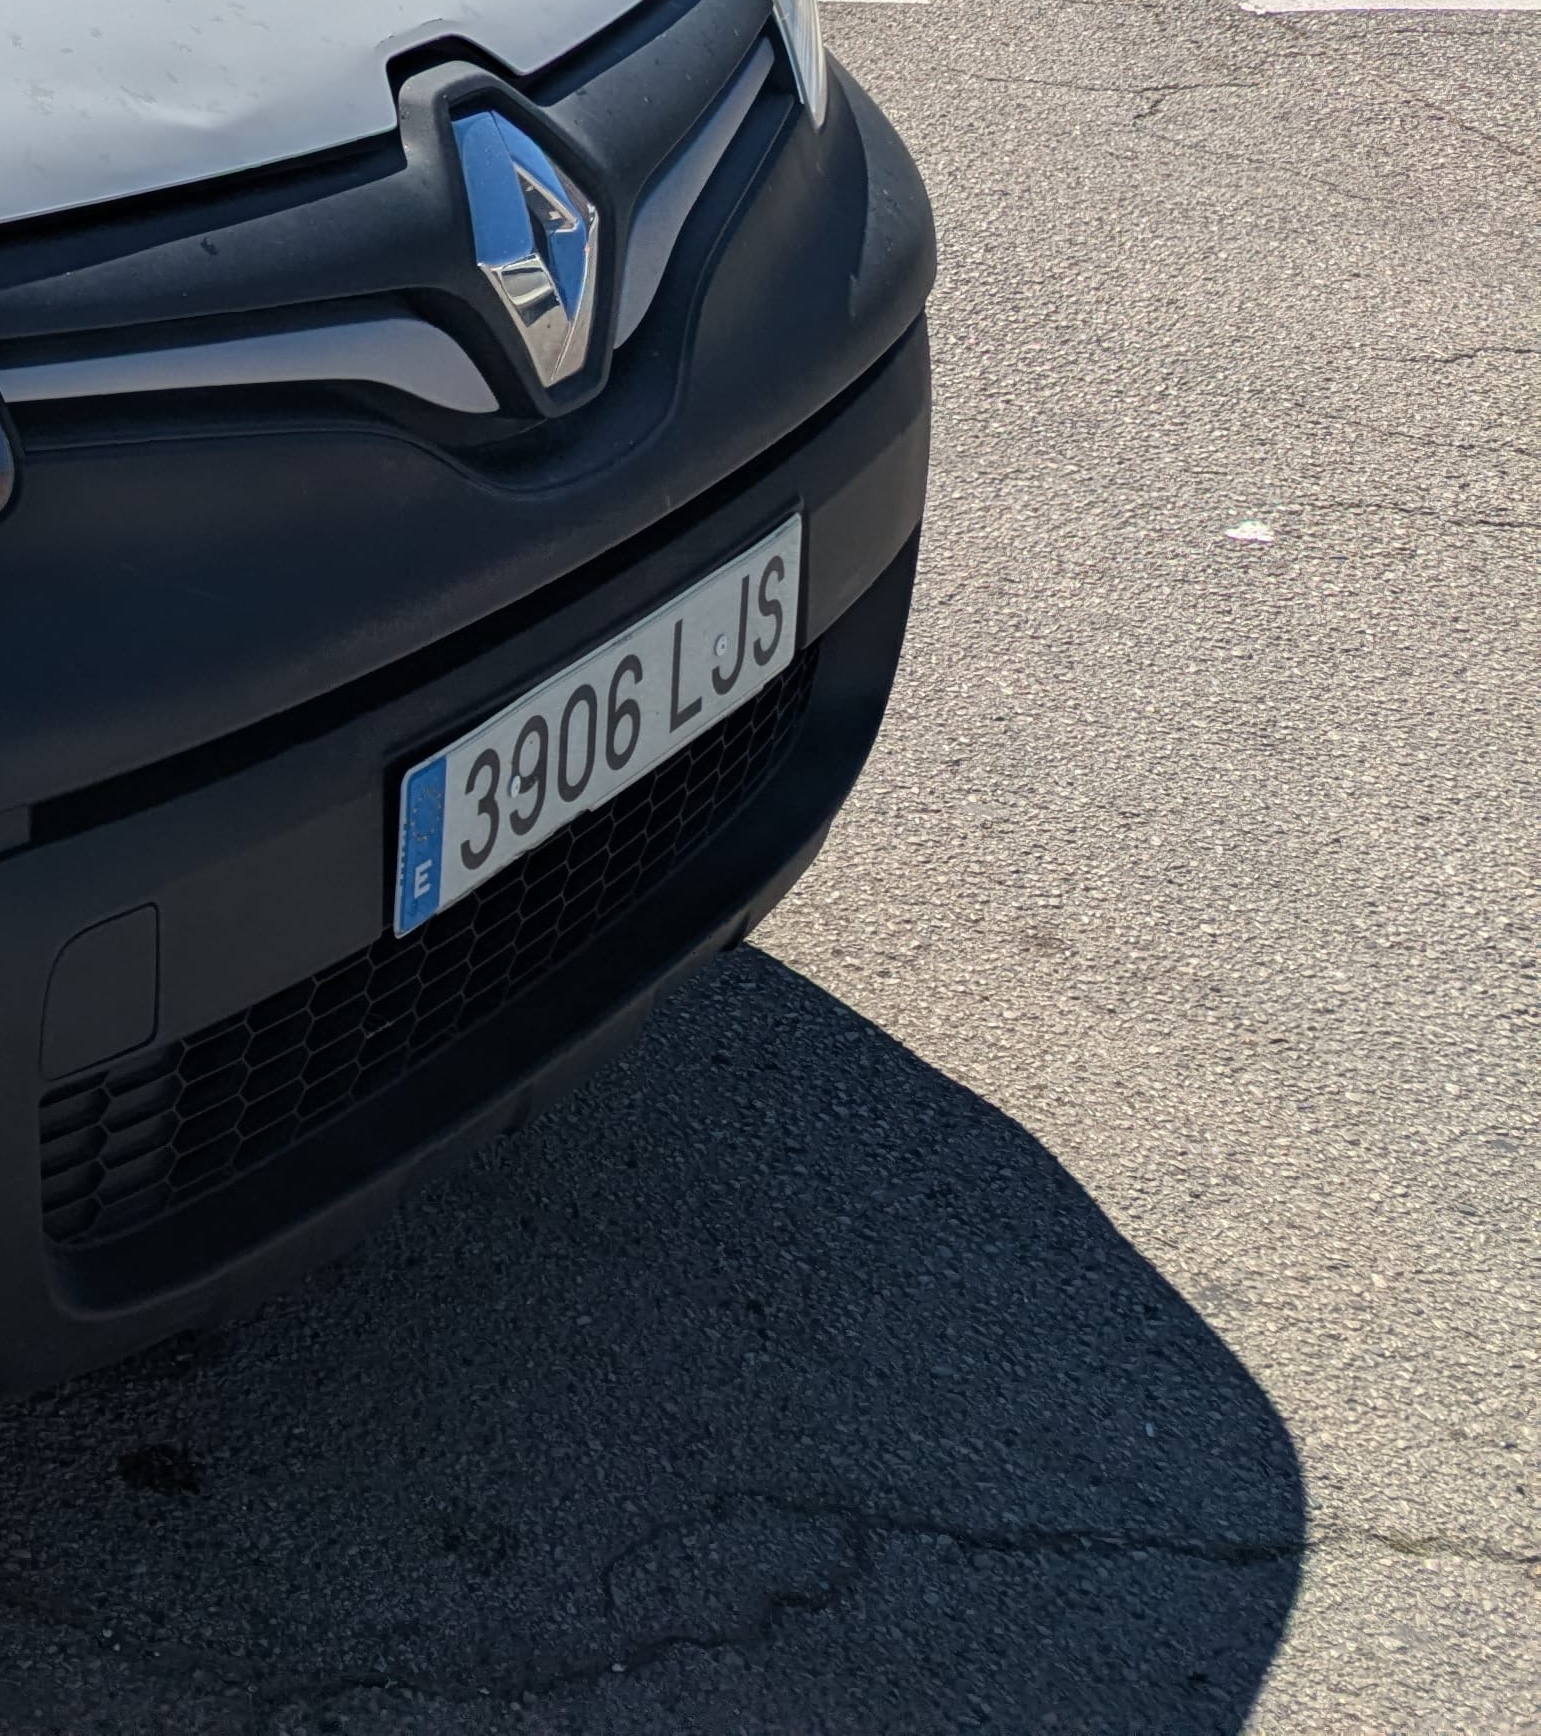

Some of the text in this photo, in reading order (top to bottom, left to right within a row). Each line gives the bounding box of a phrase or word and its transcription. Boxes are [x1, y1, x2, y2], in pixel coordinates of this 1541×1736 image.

[460, 555, 786, 871] 3906 LJS
[413, 859, 433, 899] E
